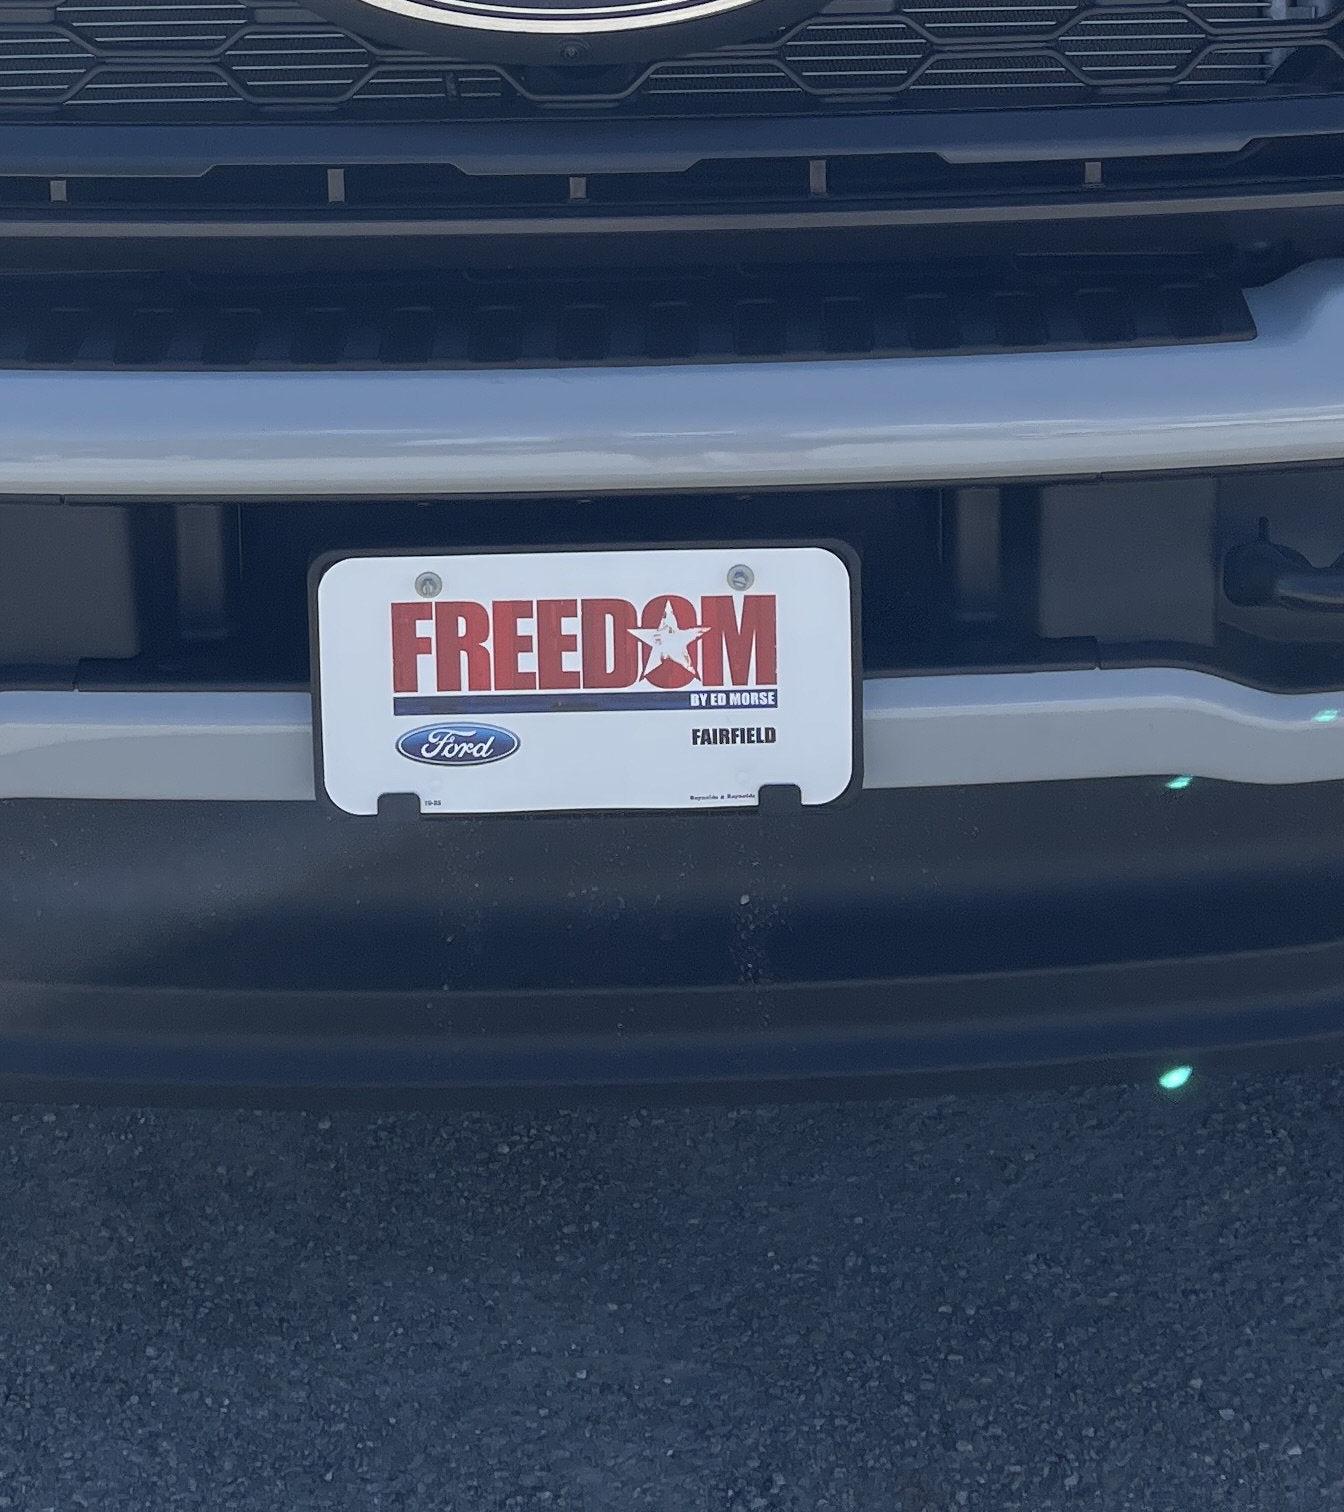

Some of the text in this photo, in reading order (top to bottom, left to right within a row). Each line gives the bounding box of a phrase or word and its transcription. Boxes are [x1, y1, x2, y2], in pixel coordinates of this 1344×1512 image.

[391, 594, 778, 693] FREEDOM
[690, 691, 776, 707] BY ED MORSE
[420, 728, 495, 758] Ford
[691, 727, 777, 746] FAIRFIELD
